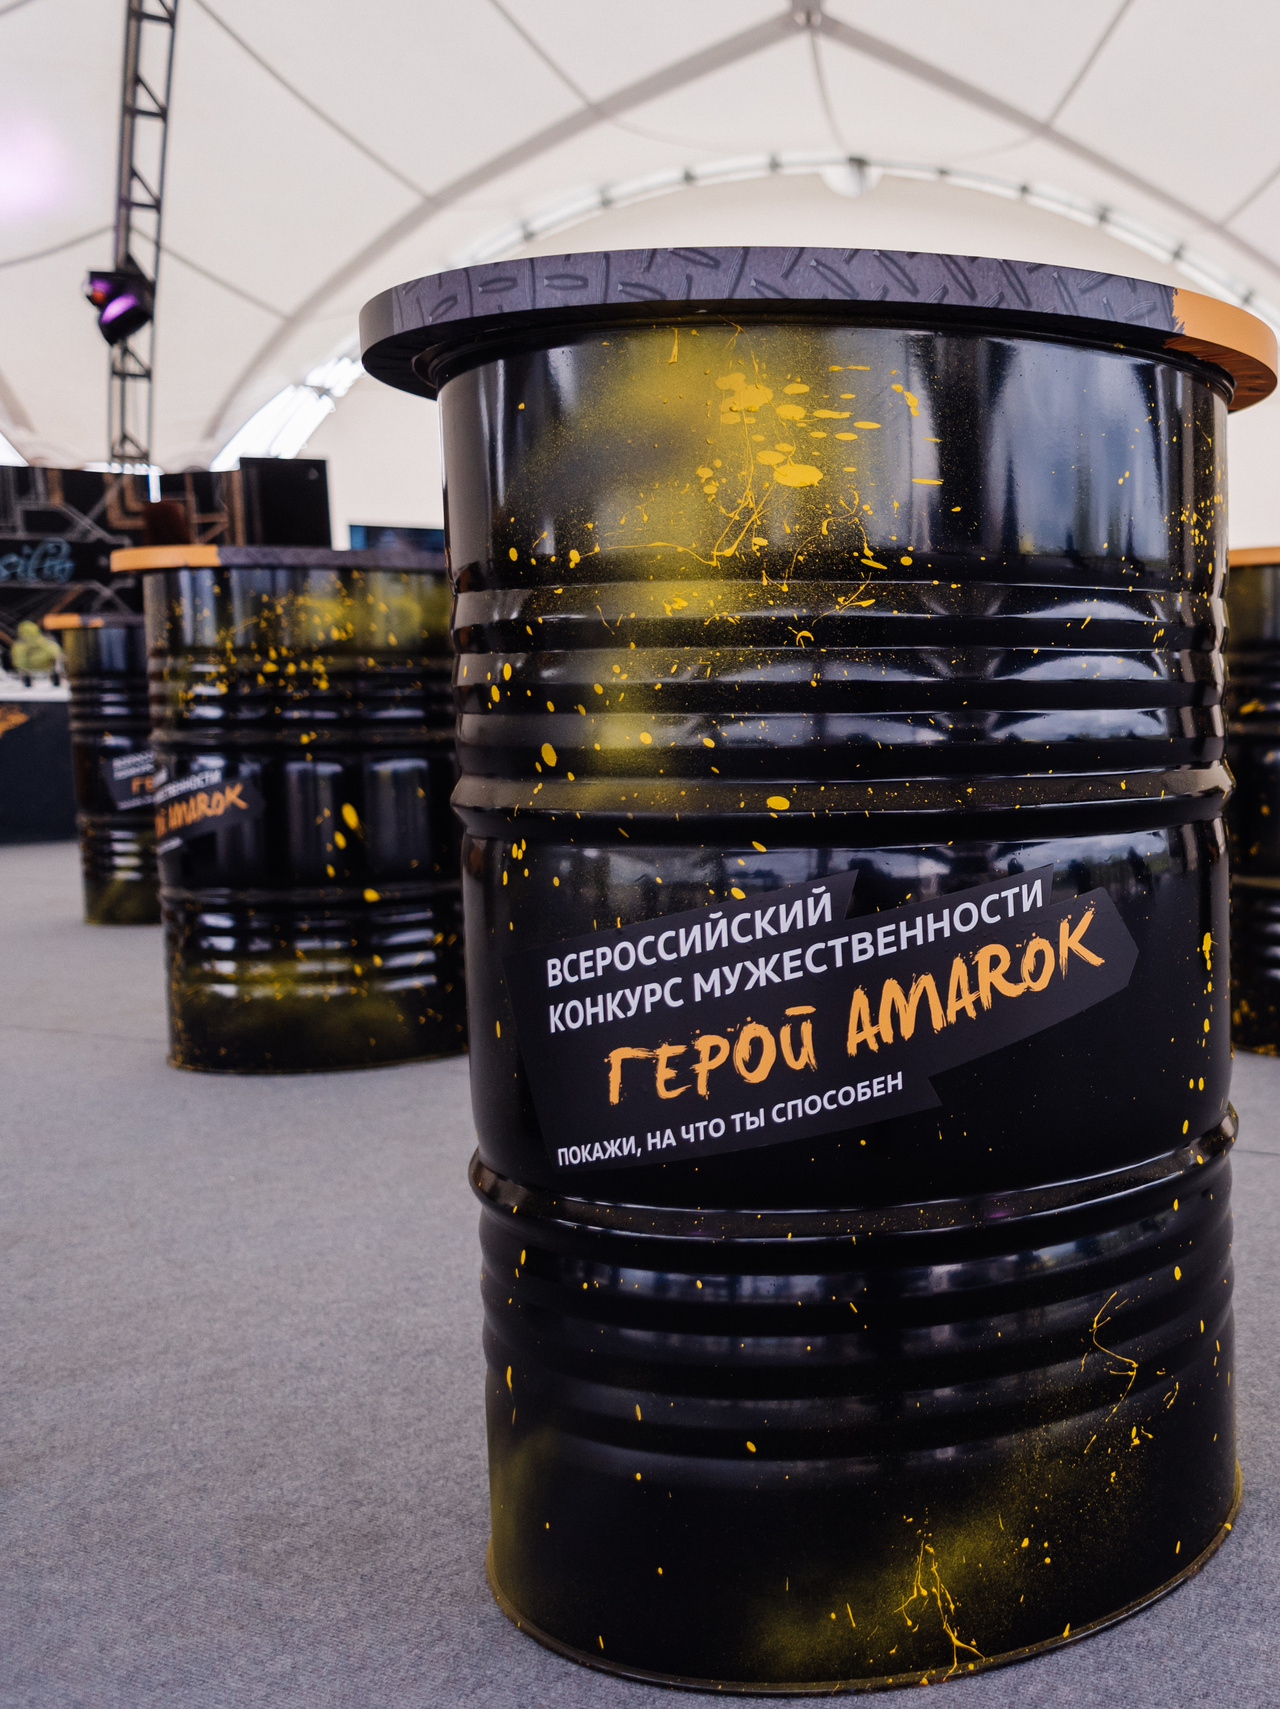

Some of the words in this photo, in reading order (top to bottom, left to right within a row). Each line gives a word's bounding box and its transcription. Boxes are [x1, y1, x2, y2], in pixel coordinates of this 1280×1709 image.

[547, 885, 832, 987] ВСЕРОССИЙСКИЙ
[549, 976, 685, 1034] КОНКУРС
[693, 879, 1044, 1003] МУЖЕСТВЕННОСТИ
[604, 1005, 817, 1106] ГЕРОЙ
[846, 902, 1106, 1058] AMAROK
[557, 1135, 643, 1167] ПОКАЖИ,
[647, 1130, 677, 1151] НА
[680, 1117, 726, 1144] ЧТО
[731, 1107, 765, 1134] ТЫ
[771, 1070, 904, 1124] СПОСОБЕН
